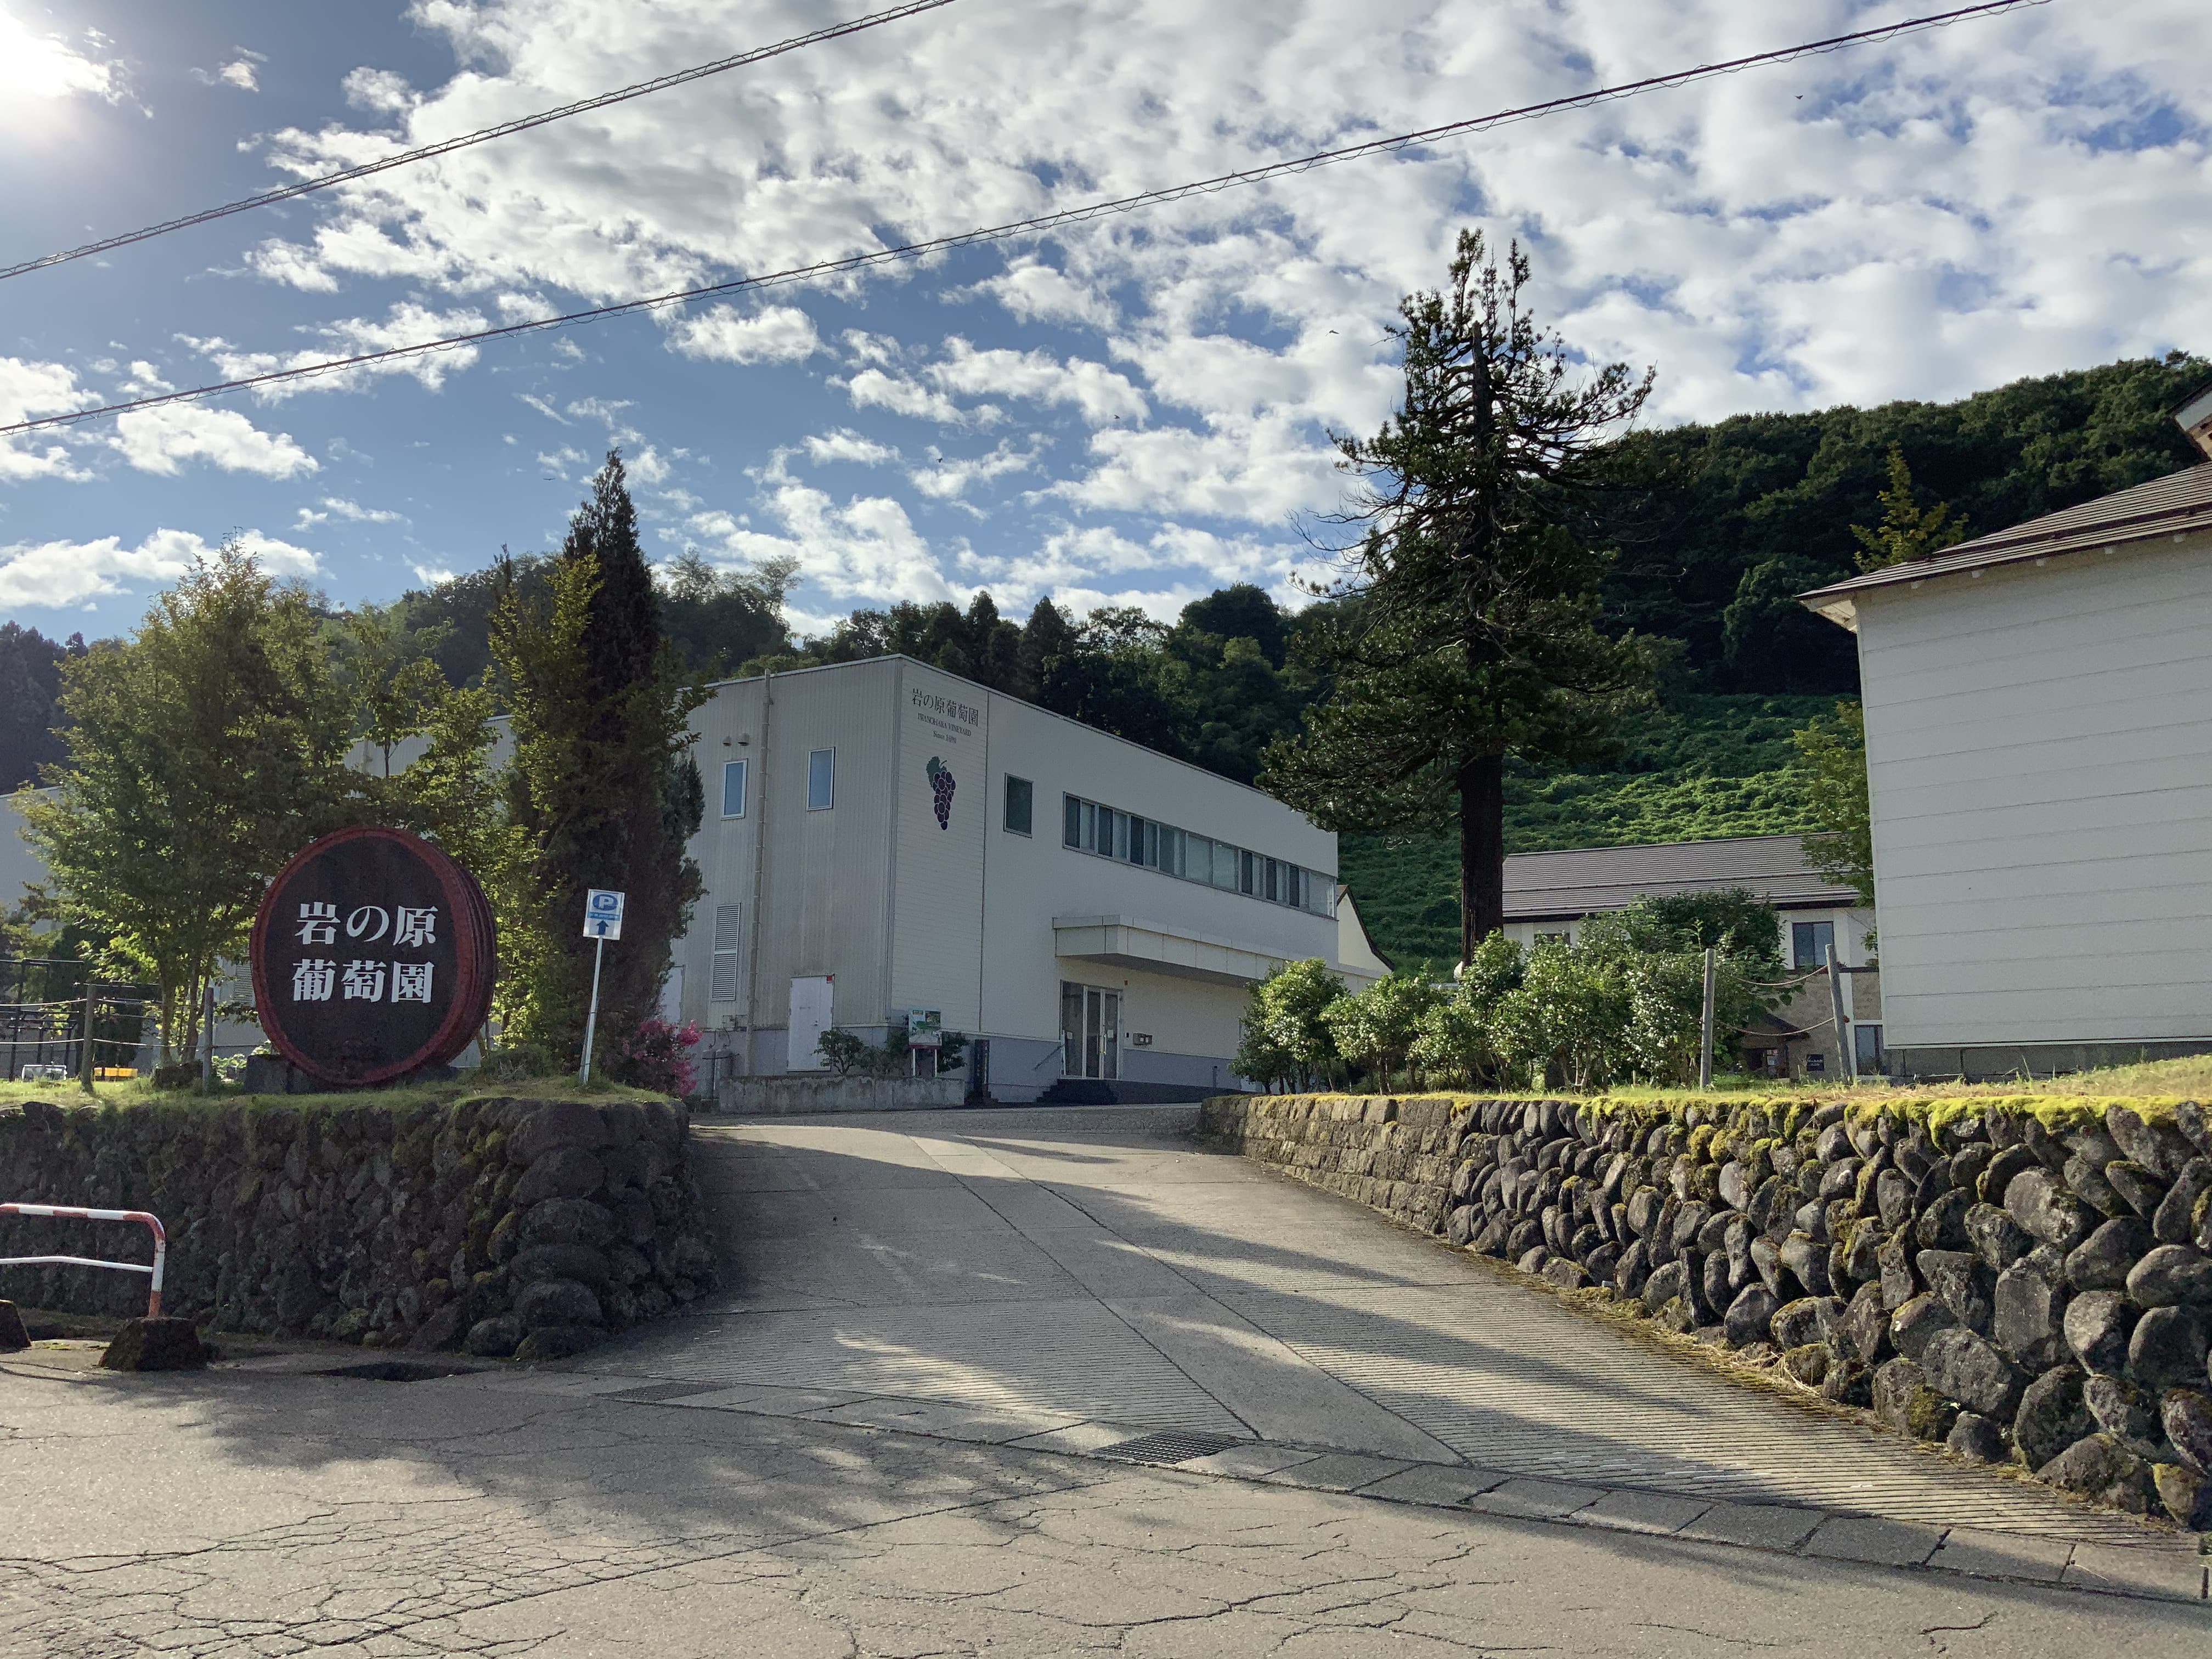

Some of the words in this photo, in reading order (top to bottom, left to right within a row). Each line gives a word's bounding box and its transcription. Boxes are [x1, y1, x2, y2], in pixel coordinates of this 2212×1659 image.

[912, 687, 979, 727] 岩の原葡萄園
[917, 713, 947, 729] IWANOHARA
[948, 723, 972, 737] VINEYARD
[933, 730, 945, 740] Since
[598, 895, 614, 909] P
[295, 901, 439, 948] 岩の原
[291, 958, 435, 1004] 葡萄園
